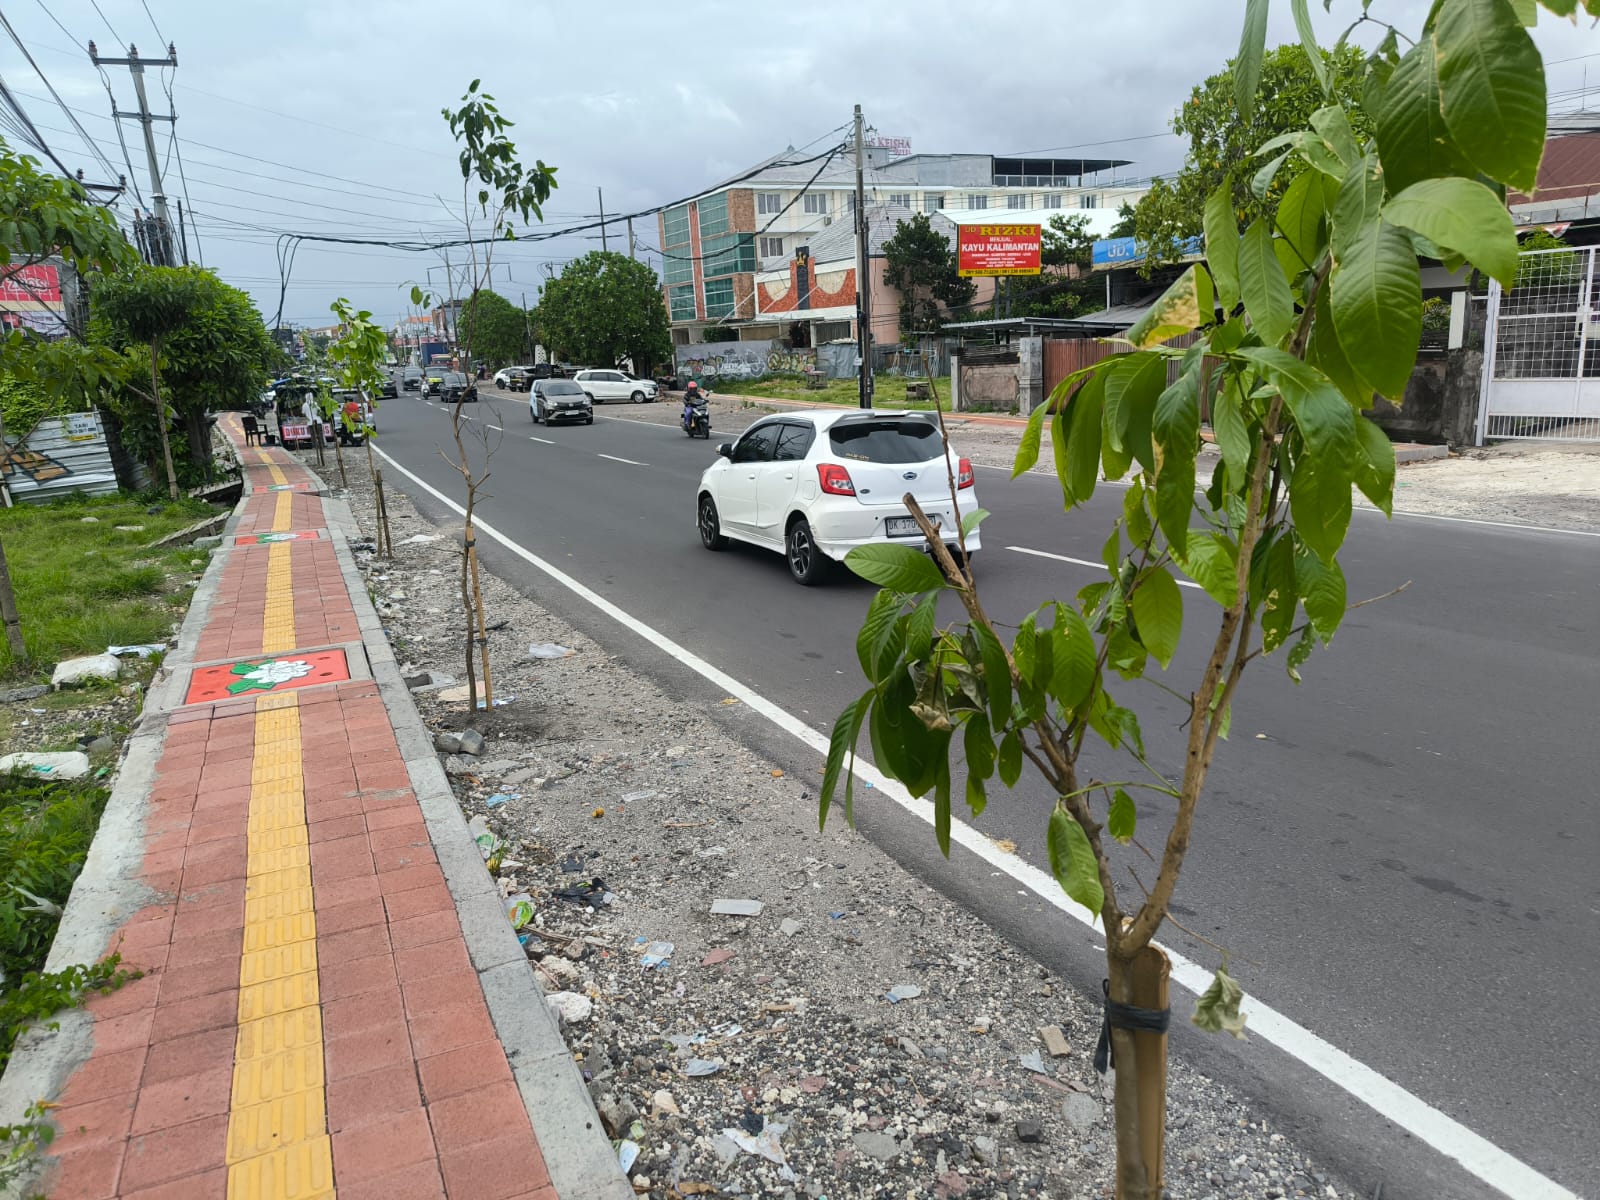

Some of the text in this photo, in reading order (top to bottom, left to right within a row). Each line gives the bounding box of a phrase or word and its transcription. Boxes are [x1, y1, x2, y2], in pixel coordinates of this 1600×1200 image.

[877, 136, 911, 149] KEISHA
[980, 226, 1036, 236] RIZKI
[961, 242, 1039, 252] KAYU KALIMANTAN
[888, 519, 899, 530] DK
